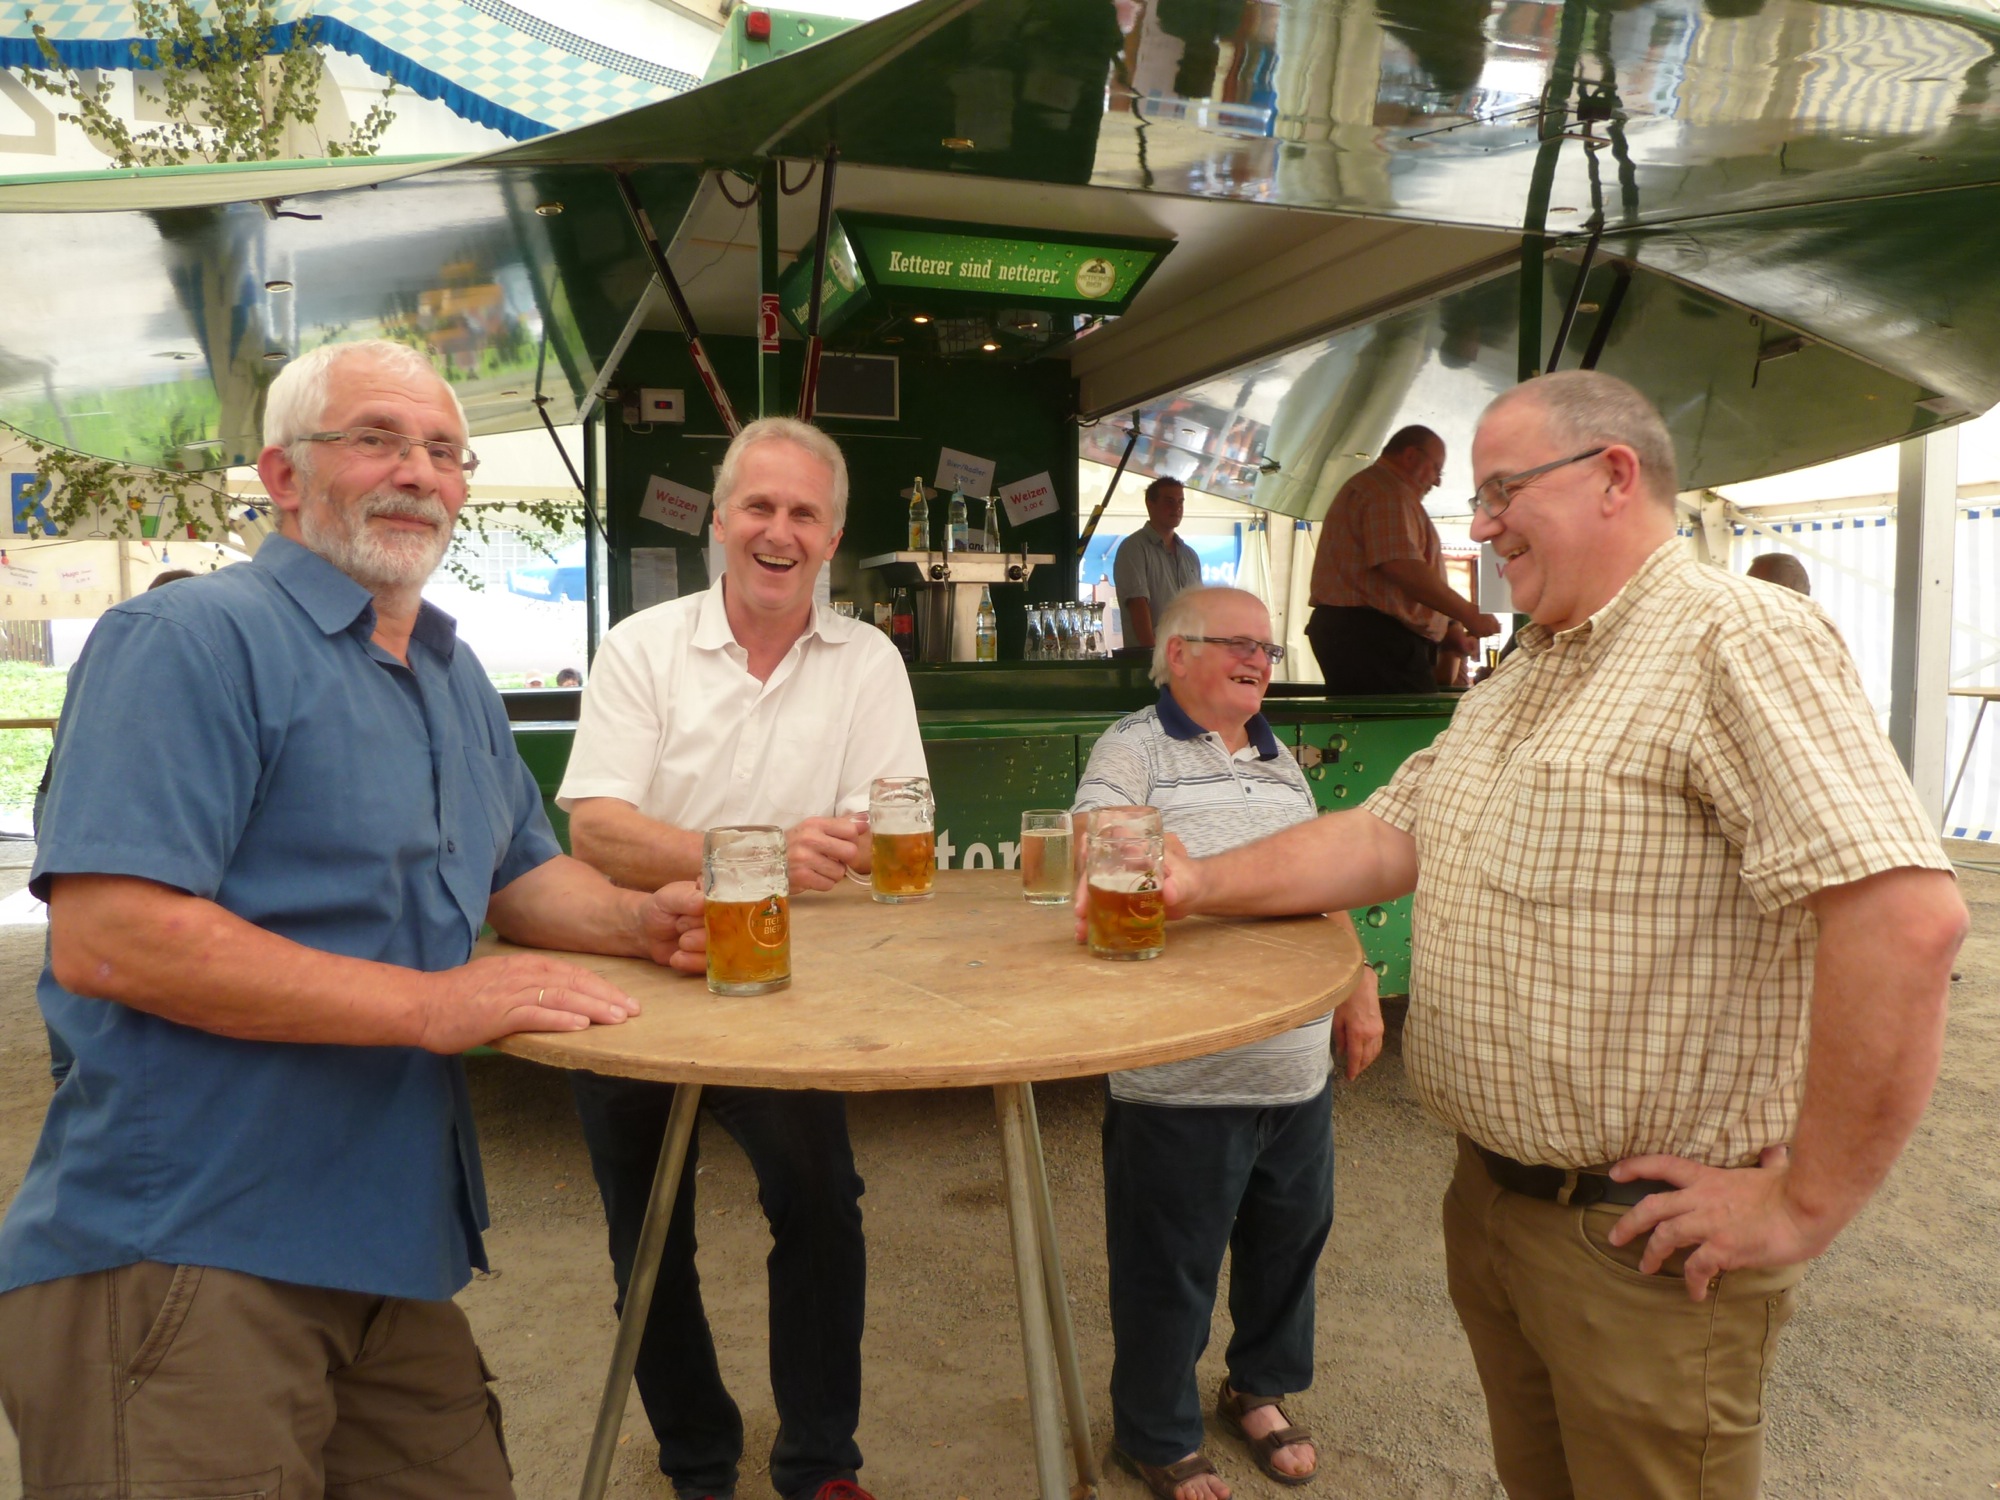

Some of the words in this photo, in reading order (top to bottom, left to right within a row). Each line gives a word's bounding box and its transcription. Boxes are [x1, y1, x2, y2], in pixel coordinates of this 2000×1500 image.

[889, 251, 953, 275] Ketterer
[960, 258, 992, 279] sind
[998, 263, 1060, 285] netterer.
[946, 459, 986, 476] Bier/Radler
[656, 489, 698, 513] Weizen
[1010, 486, 1048, 504] Weizen
[661, 506, 679, 517] 3,00
[1024, 503, 1038, 512] 3,00
